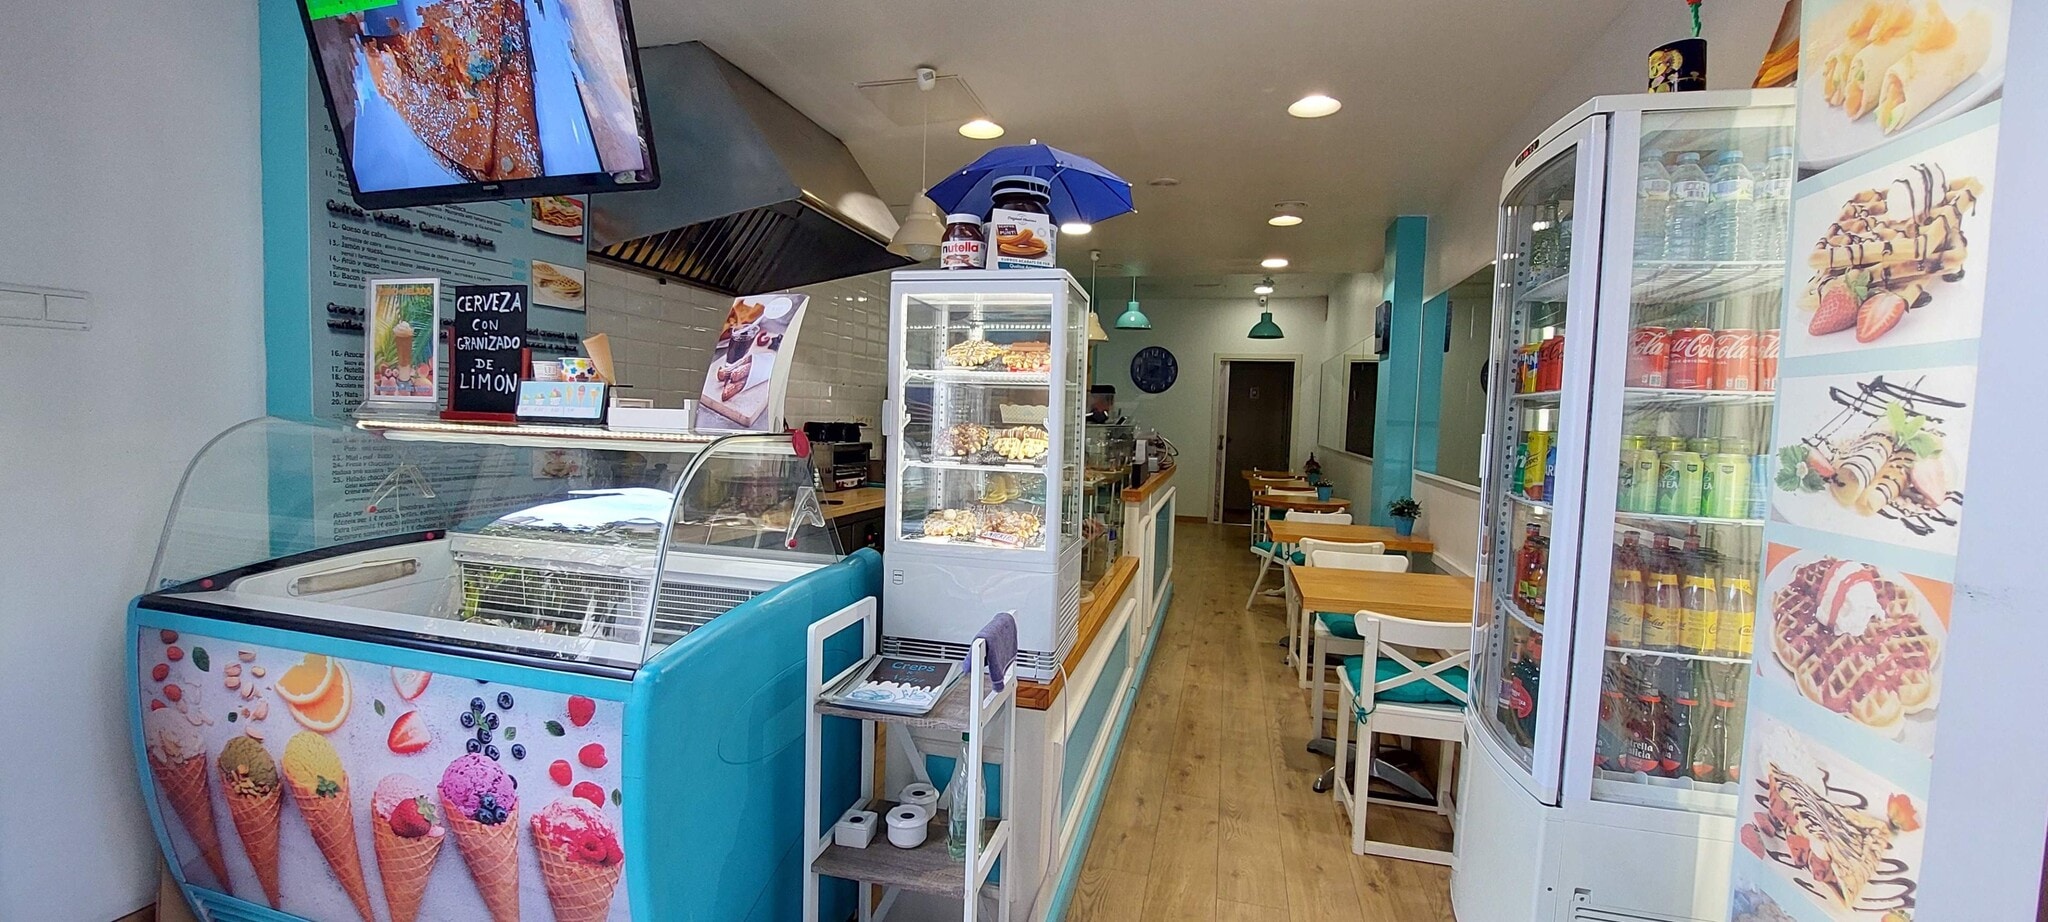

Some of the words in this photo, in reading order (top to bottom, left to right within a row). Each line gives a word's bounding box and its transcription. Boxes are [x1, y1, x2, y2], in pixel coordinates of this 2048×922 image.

[943, 242, 979, 253] nutella
[341, 272, 361, 281] Bacon
[456, 291, 522, 313] CERVEZA
[471, 319, 499, 331] CON
[457, 332, 521, 351] GRANIZADO
[474, 358, 494, 370] DE
